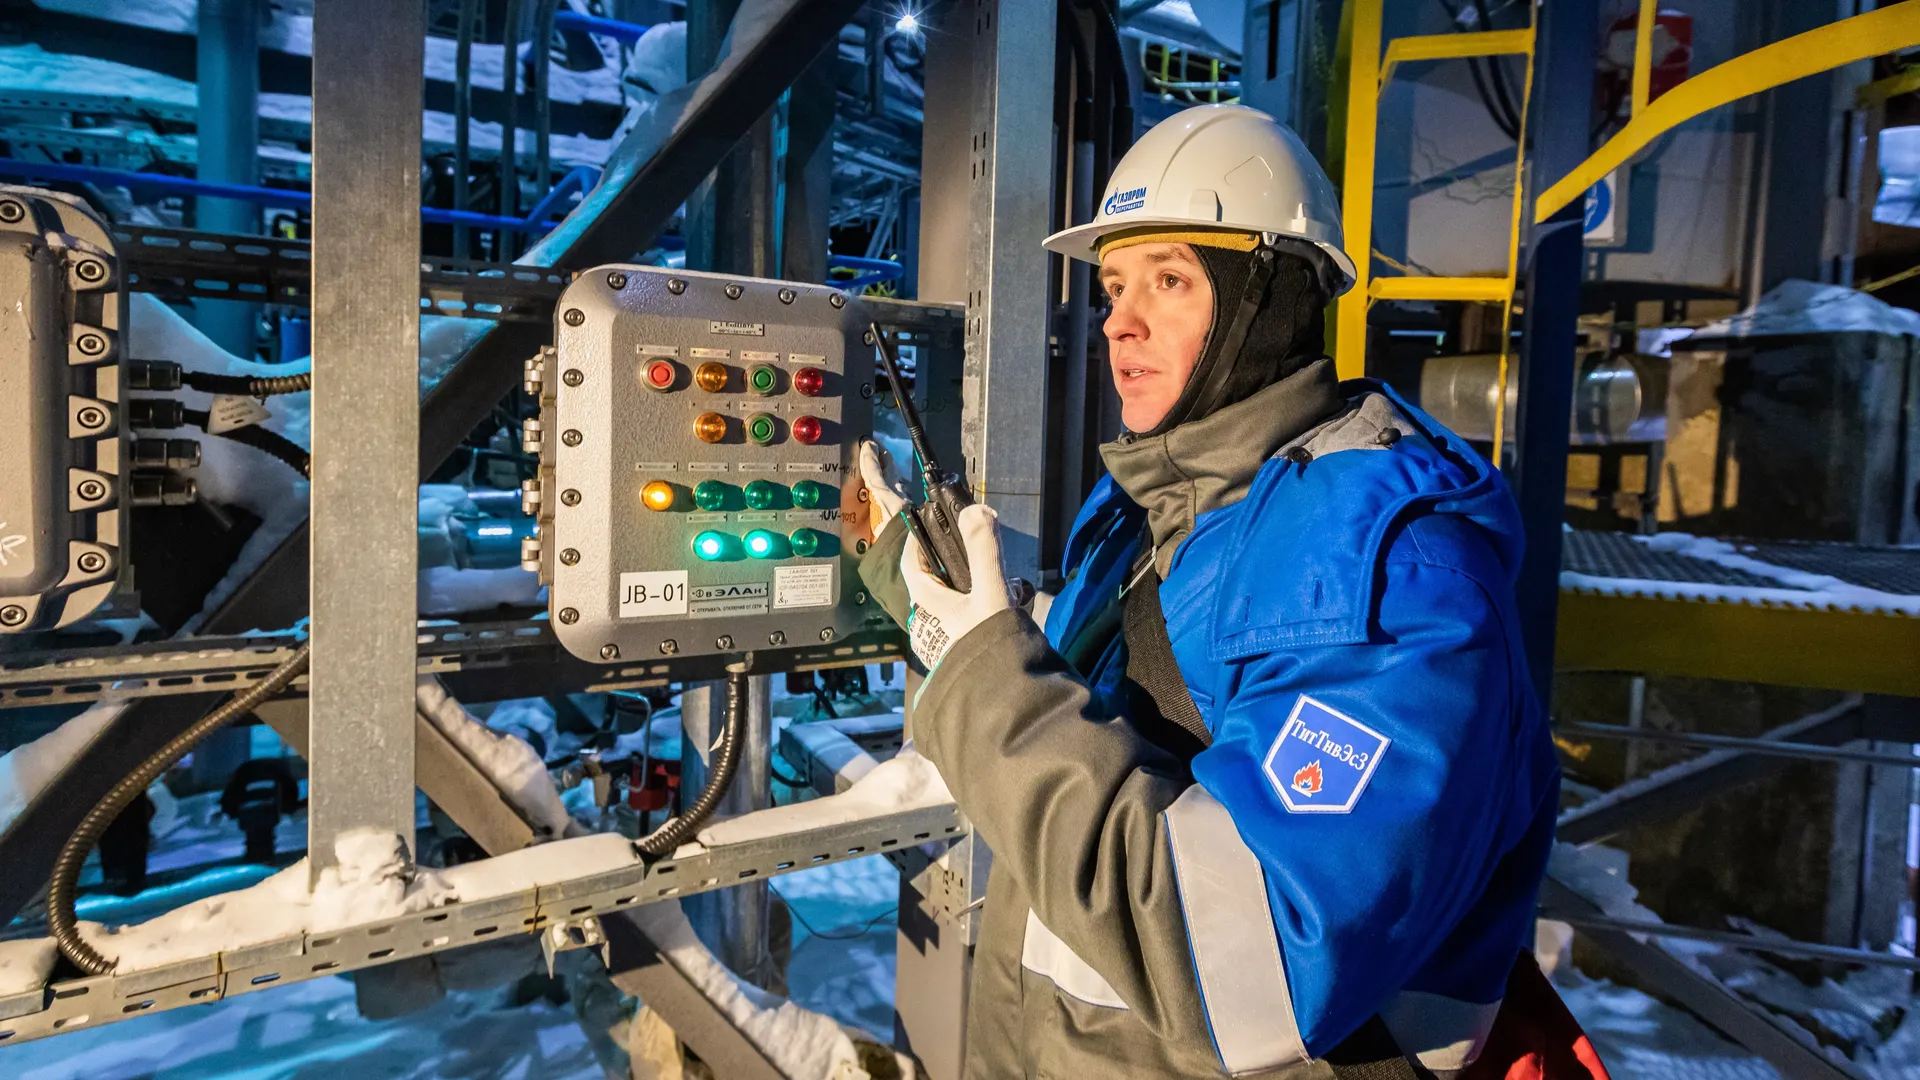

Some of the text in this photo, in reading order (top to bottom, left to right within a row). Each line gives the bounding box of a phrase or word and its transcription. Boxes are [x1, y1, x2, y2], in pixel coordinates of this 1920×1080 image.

[1117, 187, 1147, 204] ГАЗПРОМ
[823, 509, 857, 524] UV-1013
[622, 583, 684, 604] JB-01
